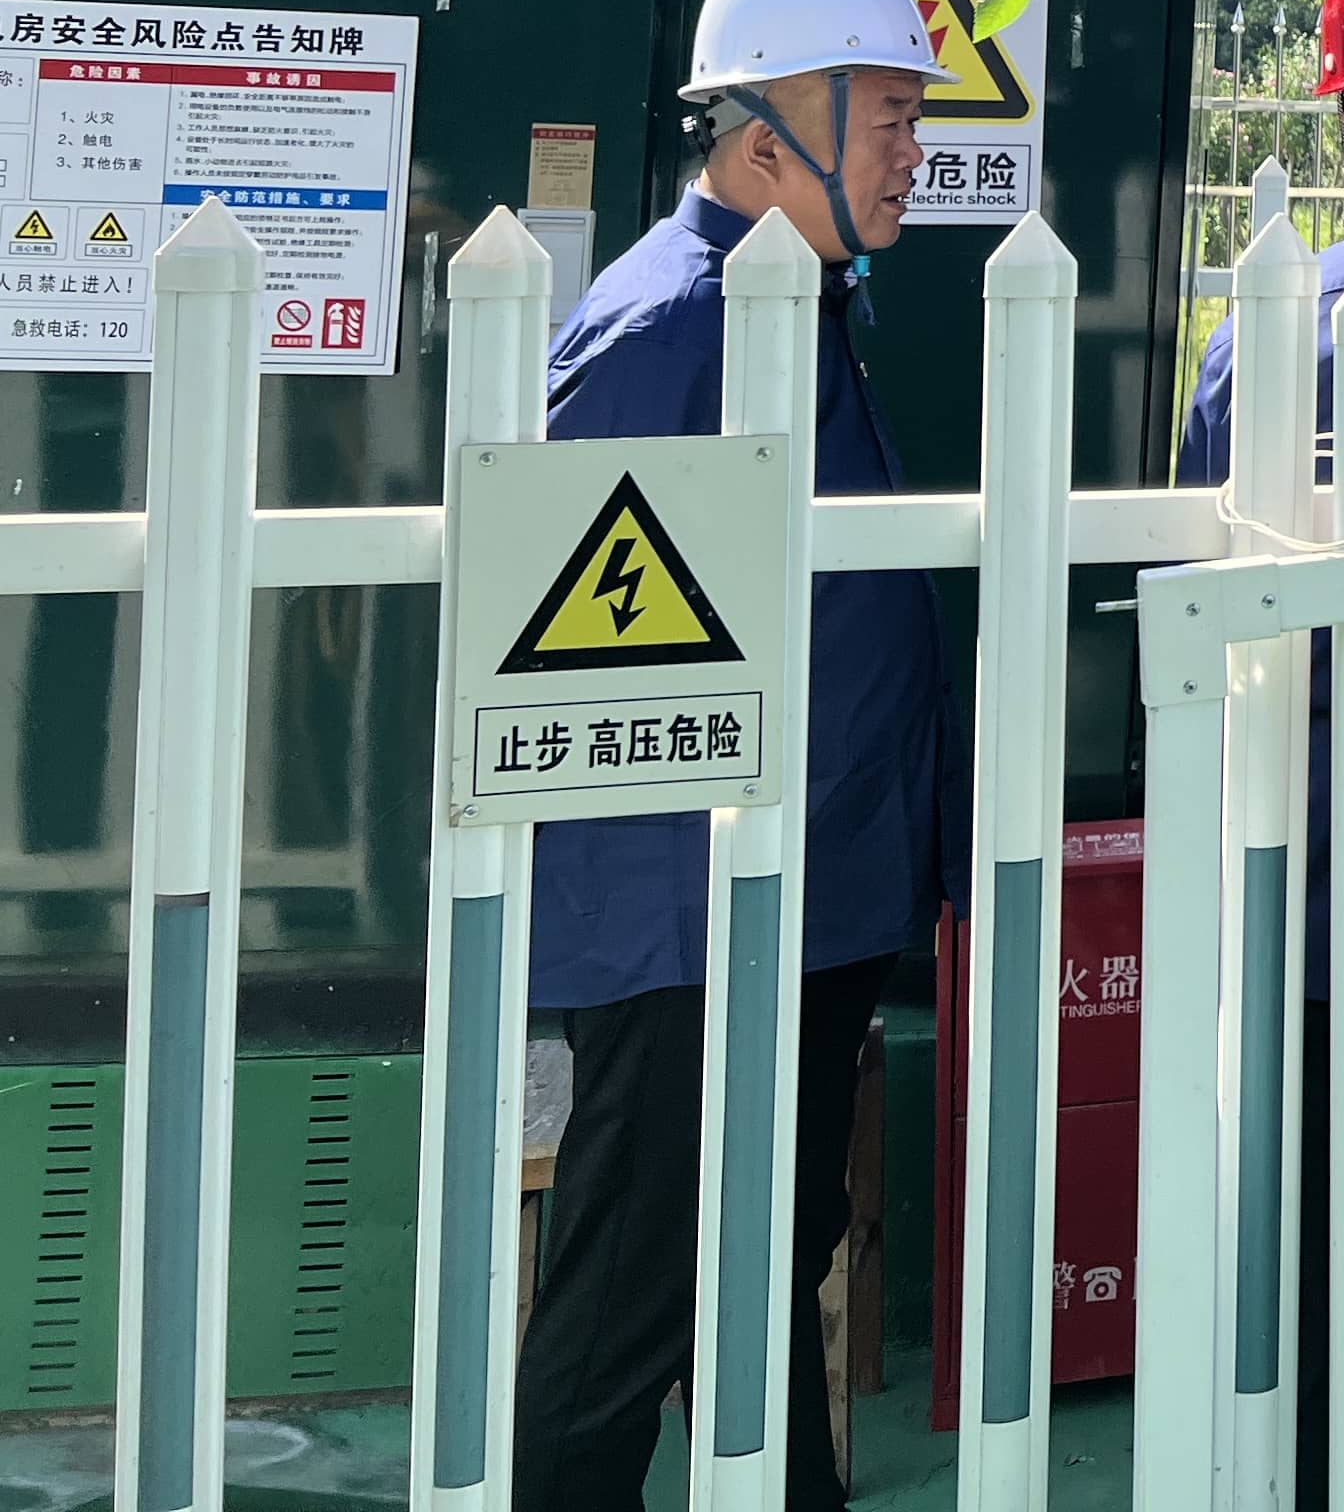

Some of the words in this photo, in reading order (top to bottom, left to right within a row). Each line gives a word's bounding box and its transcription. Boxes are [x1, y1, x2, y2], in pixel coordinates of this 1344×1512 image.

[0, 13, 365, 57] 房安全风险点告知牌
[69, 64, 142, 81] 危险因素
[910, 151, 1017, 191] 危险
[967, 191, 1017, 205] shock
[494, 721, 573, 773] 止步
[587, 711, 743, 769] 高压危险
